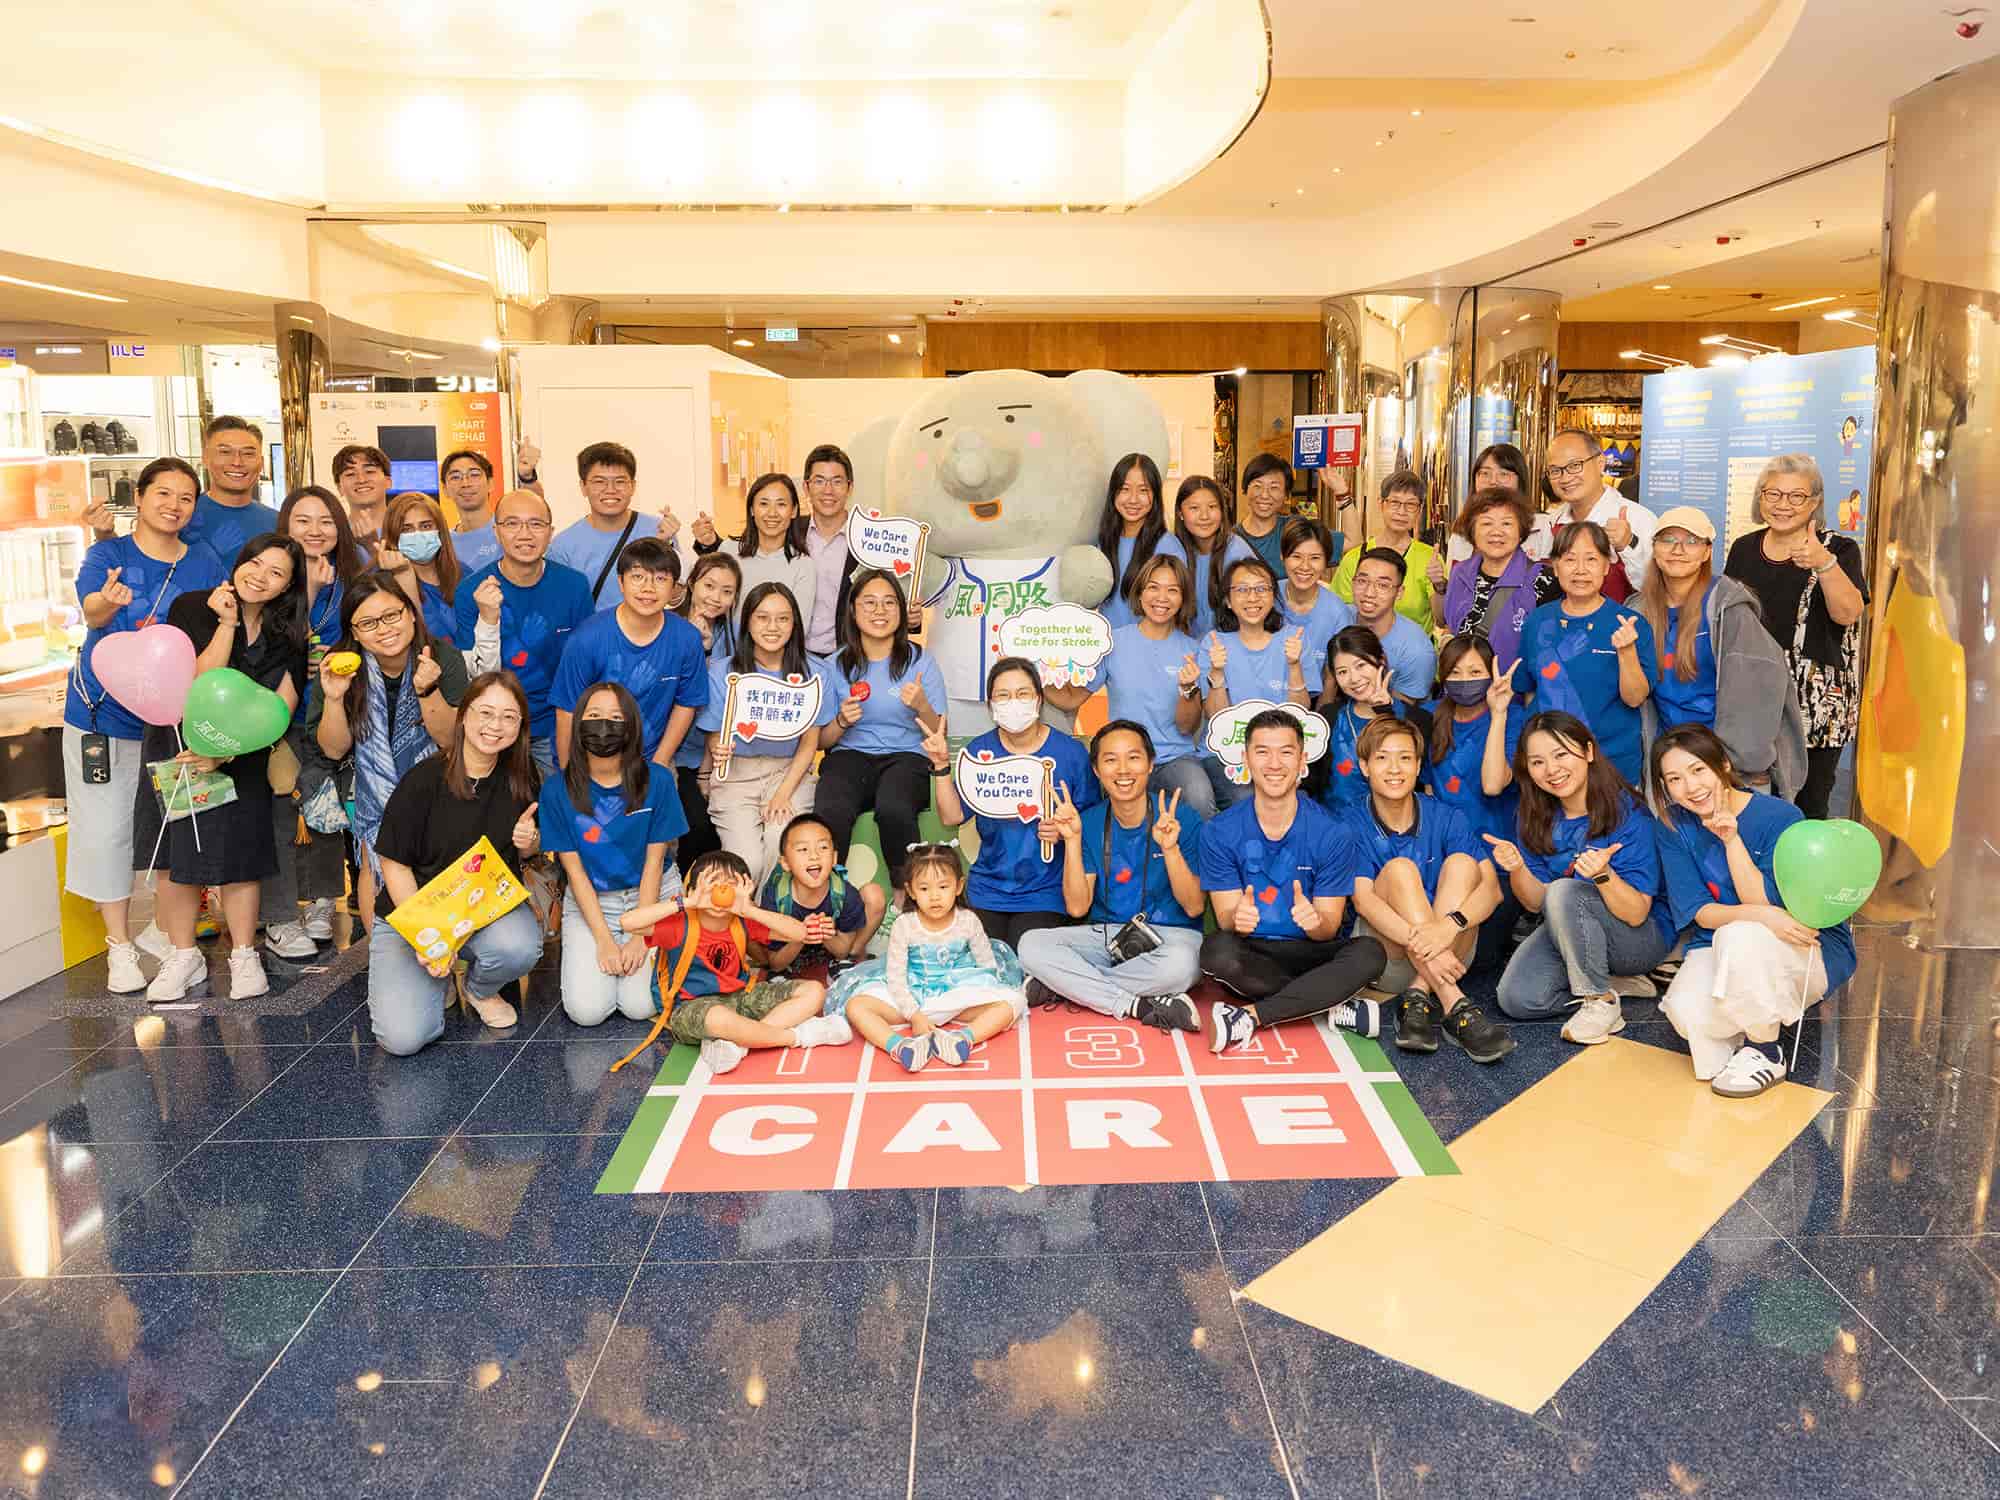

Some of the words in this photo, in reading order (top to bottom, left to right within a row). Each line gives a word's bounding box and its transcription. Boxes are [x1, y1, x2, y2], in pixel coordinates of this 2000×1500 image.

[864, 527, 880, 538] We
[881, 529, 908, 543] Care
[861, 539, 882, 552] You
[883, 542, 909, 556] Care
[1020, 624, 1072, 635] Together
[1074, 624, 1093, 634] We
[1014, 637, 1040, 647] Care
[1041, 637, 1060, 647] For
[1062, 637, 1101, 647] Stroke
[746, 689, 806, 707] 我們都是
[976, 772, 996, 784] We
[998, 772, 1029, 784] Care
[976, 786, 1000, 798] You
[1002, 786, 1033, 798] Care
[1064, 1025, 1145, 1069] 3
